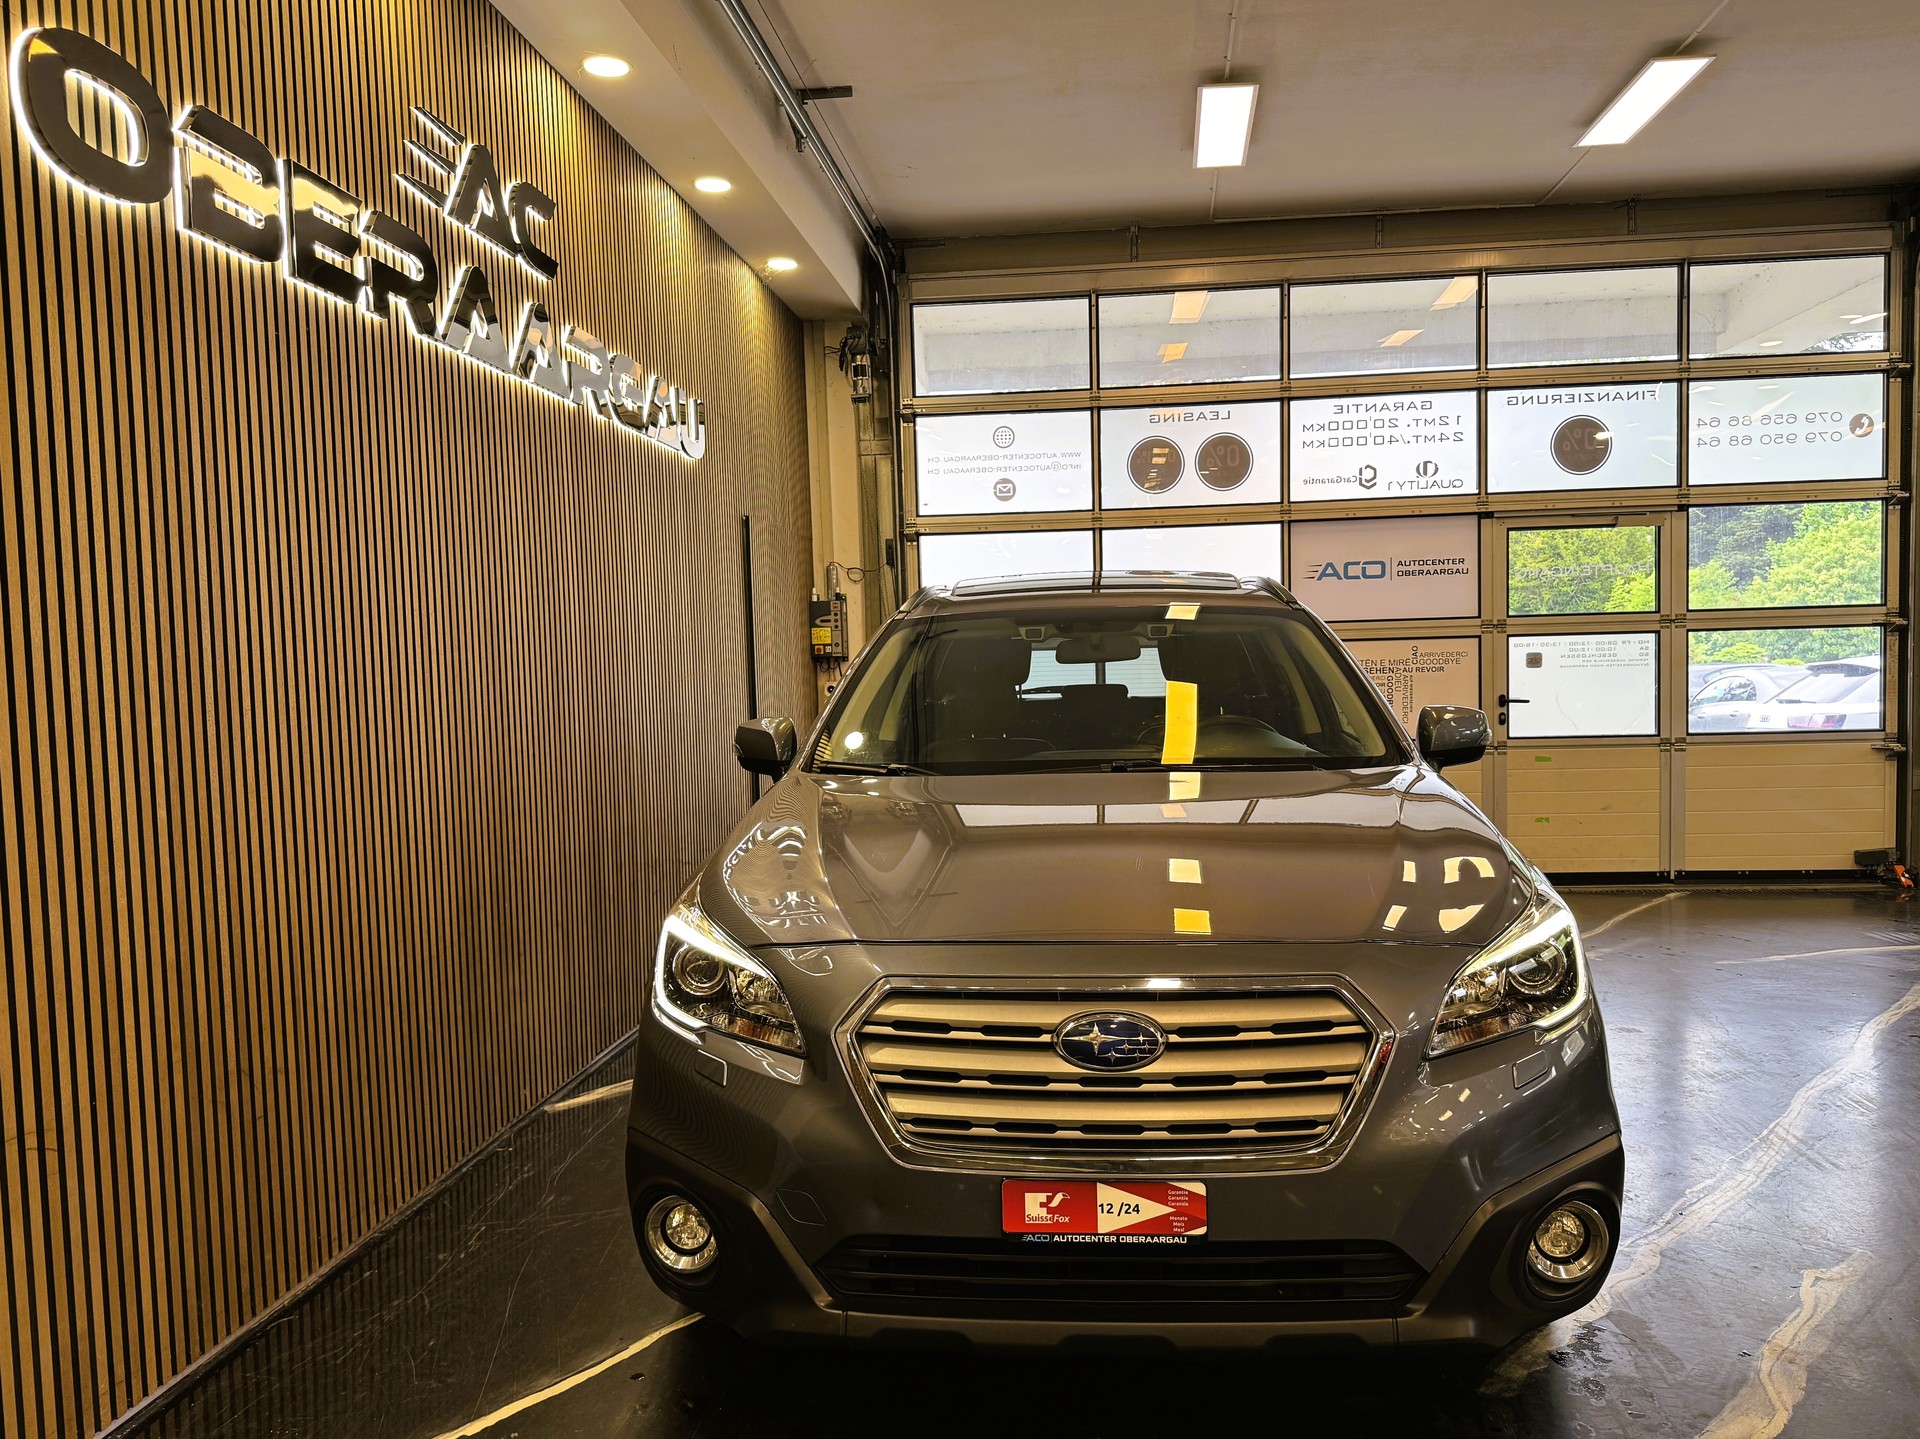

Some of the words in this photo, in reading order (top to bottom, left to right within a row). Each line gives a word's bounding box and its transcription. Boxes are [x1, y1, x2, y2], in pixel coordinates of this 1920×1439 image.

[9, 26, 705, 460] OBERAARGAU
[1396, 558, 1465, 567] AUTOCENTER
[1316, 560, 1387, 581] ACO
[1396, 567, 1469, 577] OBERAARGAU
[1098, 1203, 1114, 1214] 12
[1026, 1234, 1050, 1242] ACO
[1053, 1234, 1117, 1243] AUTOCENTER
[1119, 1235, 1187, 1244] OBERAARGAU
